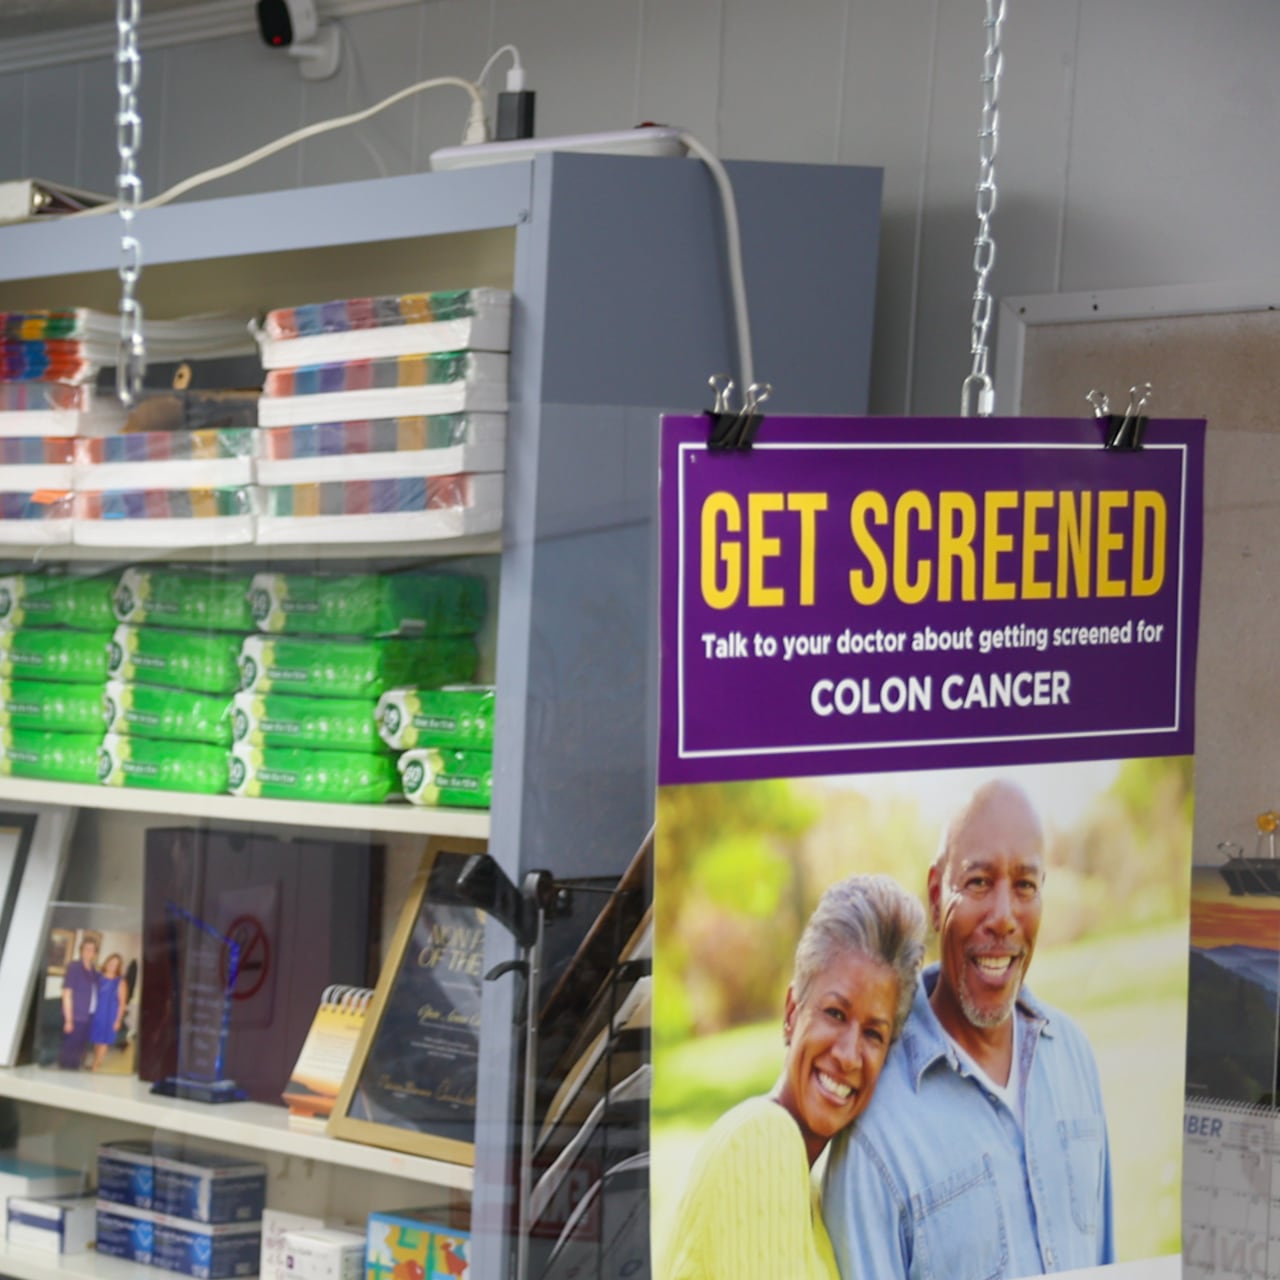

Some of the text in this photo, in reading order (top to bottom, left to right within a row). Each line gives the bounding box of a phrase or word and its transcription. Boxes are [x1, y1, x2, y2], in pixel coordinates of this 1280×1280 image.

[700, 489, 1167, 611] GET SCREENED
[702, 619, 1164, 661] Talk to your doctor about getting screened for
[810, 671, 1071, 716] COLON CANCER
[1184, 1114, 1223, 1138] BER
